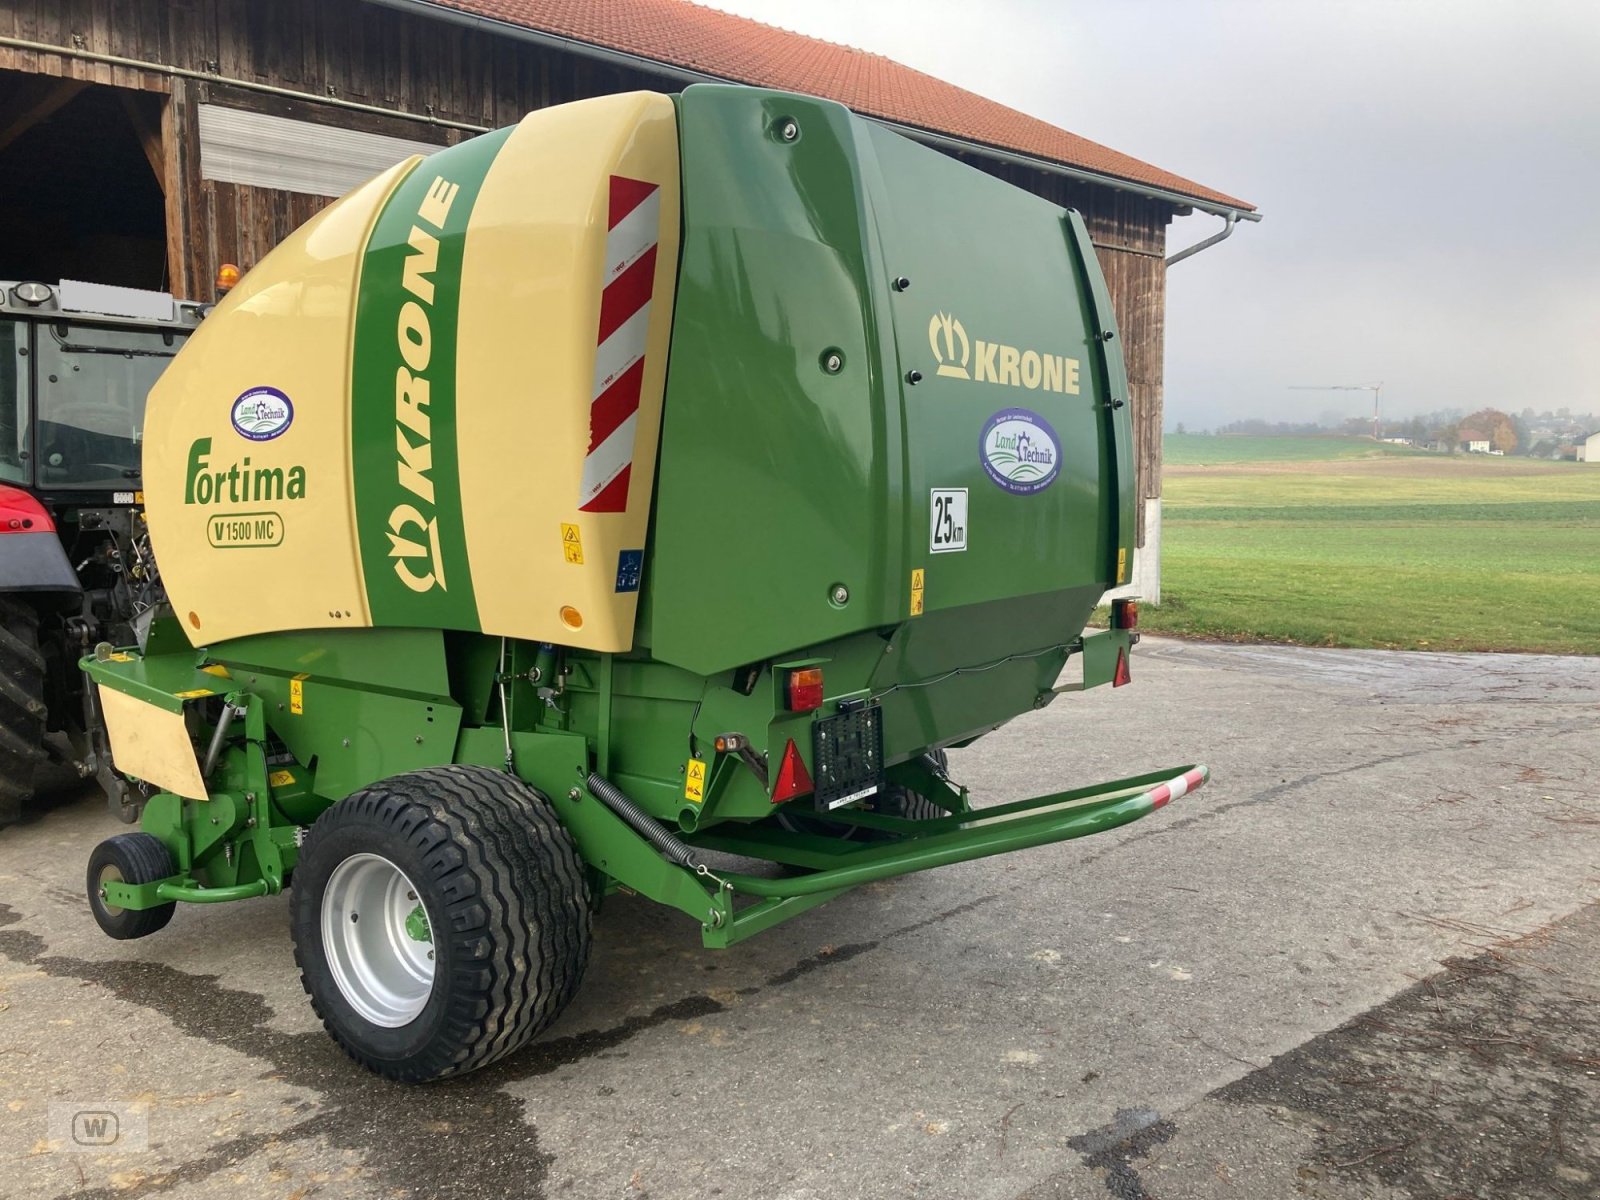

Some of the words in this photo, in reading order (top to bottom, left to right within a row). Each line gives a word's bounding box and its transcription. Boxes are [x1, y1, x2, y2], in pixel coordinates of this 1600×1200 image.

[396, 175, 460, 506] KRONE
[975, 340, 1080, 395] KRONE
[260, 408, 286, 420] Technik
[995, 431, 1017, 450] Land
[1022, 446, 1053, 465] Technik
[184, 436, 306, 505] Fortima
[215, 522, 225, 541] V
[226, 521, 252, 541] 1500
[255, 520, 274, 540] MC
[934, 496, 953, 544] 25
[952, 521, 964, 543] km
